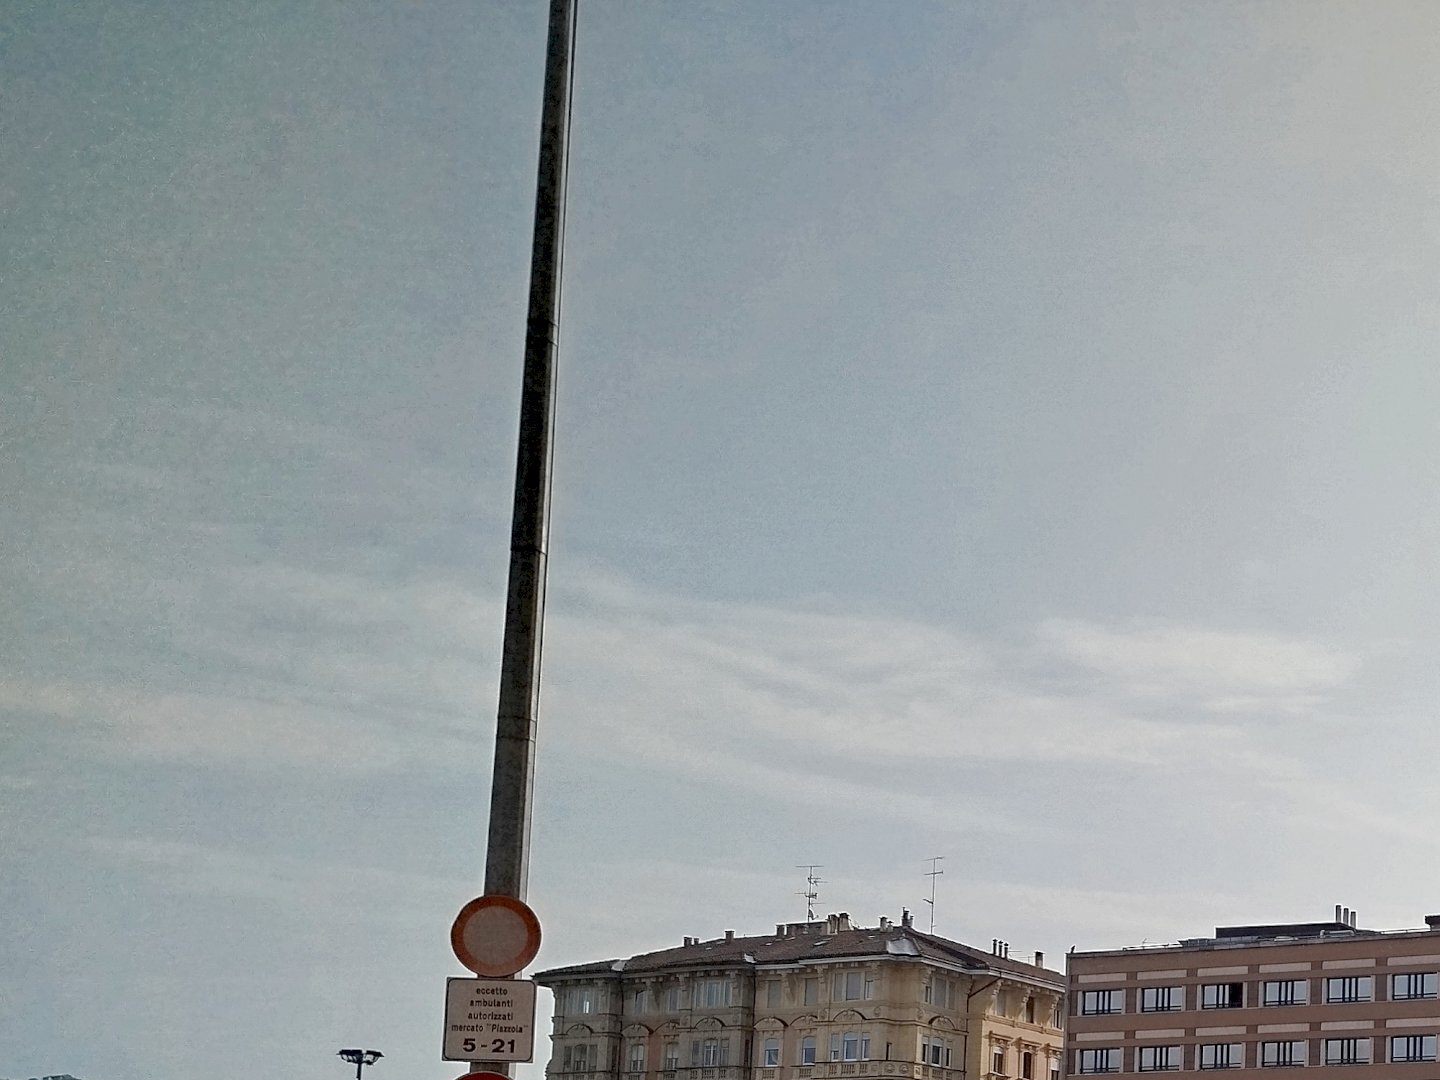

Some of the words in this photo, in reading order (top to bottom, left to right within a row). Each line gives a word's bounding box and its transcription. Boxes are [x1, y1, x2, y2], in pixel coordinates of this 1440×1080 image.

[475, 987, 508, 996] eccetto
[469, 999, 513, 1008] ambulanti
[467, 1012, 514, 1021] autorizzati
[451, 1024, 484, 1033] mercato
